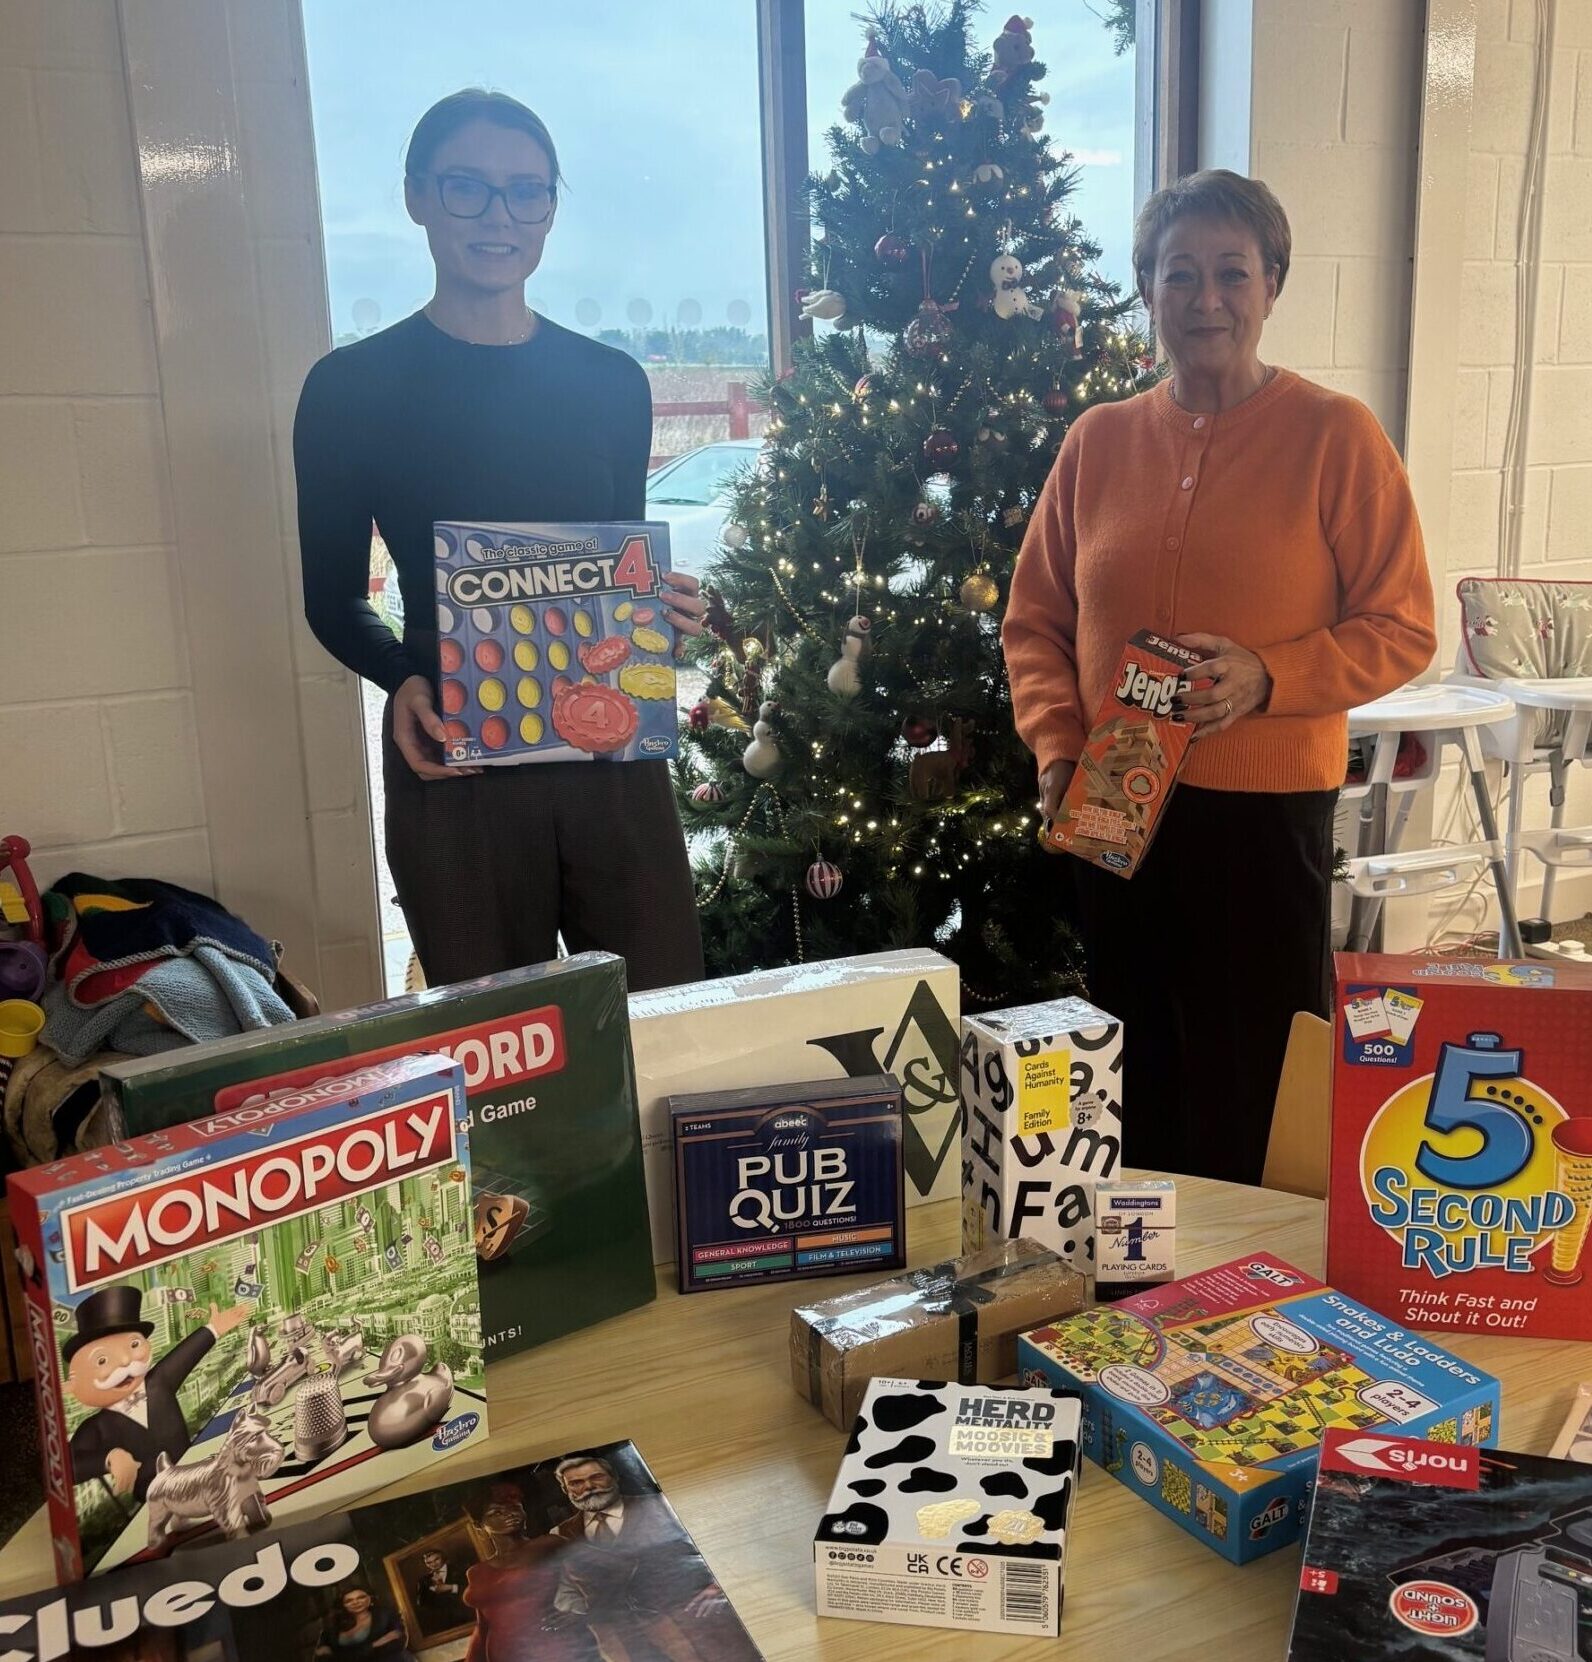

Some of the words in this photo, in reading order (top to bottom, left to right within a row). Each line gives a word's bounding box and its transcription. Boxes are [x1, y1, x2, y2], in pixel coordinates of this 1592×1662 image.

[483, 548, 504, 560] The
[506, 544, 547, 558] classic
[549, 542, 580, 556] game
[580, 538, 598, 551] of
[453, 558, 614, 603] CONNECT
[614, 539, 655, 594] 4
[1145, 635, 1203, 662] Jenga
[1359, 1055, 1397, 1064] Questions!
[1363, 1043, 1395, 1056] 500
[1024, 1060, 1050, 1072] Cards
[1024, 1068, 1056, 1082] Against
[1024, 1077, 1065, 1090] Humanity
[206, 1071, 382, 1134] MONOPOLY
[480, 1096, 537, 1123] Game
[1414, 1036, 1535, 1190] 5
[1023, 1108, 1051, 1121] Family
[1023, 1118, 1052, 1130] Edition
[1077, 1112, 1092, 1125] 8+
[690, 1122, 712, 1131] TEAMS
[768, 1131, 810, 1151] family
[116, 1172, 152, 1190] Property
[152, 1163, 182, 1180] Trading
[182, 1157, 205, 1168] Game
[737, 1147, 847, 1190] PUB
[84, 1104, 444, 1274] MONOPOLY
[729, 1180, 857, 1234] QUIZ
[1113, 1198, 1159, 1208] Waddingtons
[1369, 1165, 1577, 1235] SECOND
[812, 1215, 857, 1227] QUESTIONS!
[832, 1232, 857, 1244] MUSIC
[1108, 1230, 1161, 1249] Number
[1123, 1216, 1147, 1261] 1
[697, 1246, 736, 1260] GENERAL
[736, 1240, 789, 1257] KNOWLEDGE
[808, 1250, 827, 1261] FILM
[828, 1251, 835, 1259] &
[836, 1245, 882, 1258] TELEVISION
[1401, 1226, 1534, 1279] RULE
[730, 1260, 757, 1271] SPORT
[1101, 1263, 1137, 1271] PLAYING
[1139, 1263, 1167, 1271] CARDS
[1250, 1262, 1292, 1286] GALT
[1399, 1289, 1450, 1306] Think
[1454, 1293, 1495, 1308] Fast
[1500, 1296, 1537, 1312] and
[1404, 1307, 1462, 1325] Shout
[1465, 1311, 1479, 1326] it
[1485, 1312, 1528, 1329] Out!
[1321, 1294, 1387, 1333] Snakes
[1385, 1331, 1405, 1343] &
[1403, 1339, 1482, 1386] Ladders
[1336, 1316, 1378, 1340] and
[1372, 1338, 1421, 1367] Ludo
[29, 1308, 68, 1502] MONOPOLY
[958, 1397, 1056, 1422] HERD
[1369, 1393, 1410, 1417] players
[1385, 1388, 1422, 1410] 2-4
[434, 1416, 477, 1441] Hasbro
[954, 1416, 1053, 1430] MENTALITY
[956, 1429, 1031, 1443] MOOSIC
[1033, 1433, 1048, 1443] &
[955, 1441, 1047, 1455] MOOVIES
[1388, 1449, 1468, 1473] noris
[1251, 1506, 1289, 1531] GALT
[907, 1552, 928, 1564] UK
[936, 1556, 963, 1577] CE
[907, 1563, 929, 1575] CA
[1402, 1589, 1467, 1609] SOUND
[1408, 1608, 1459, 1627] LIGHT
